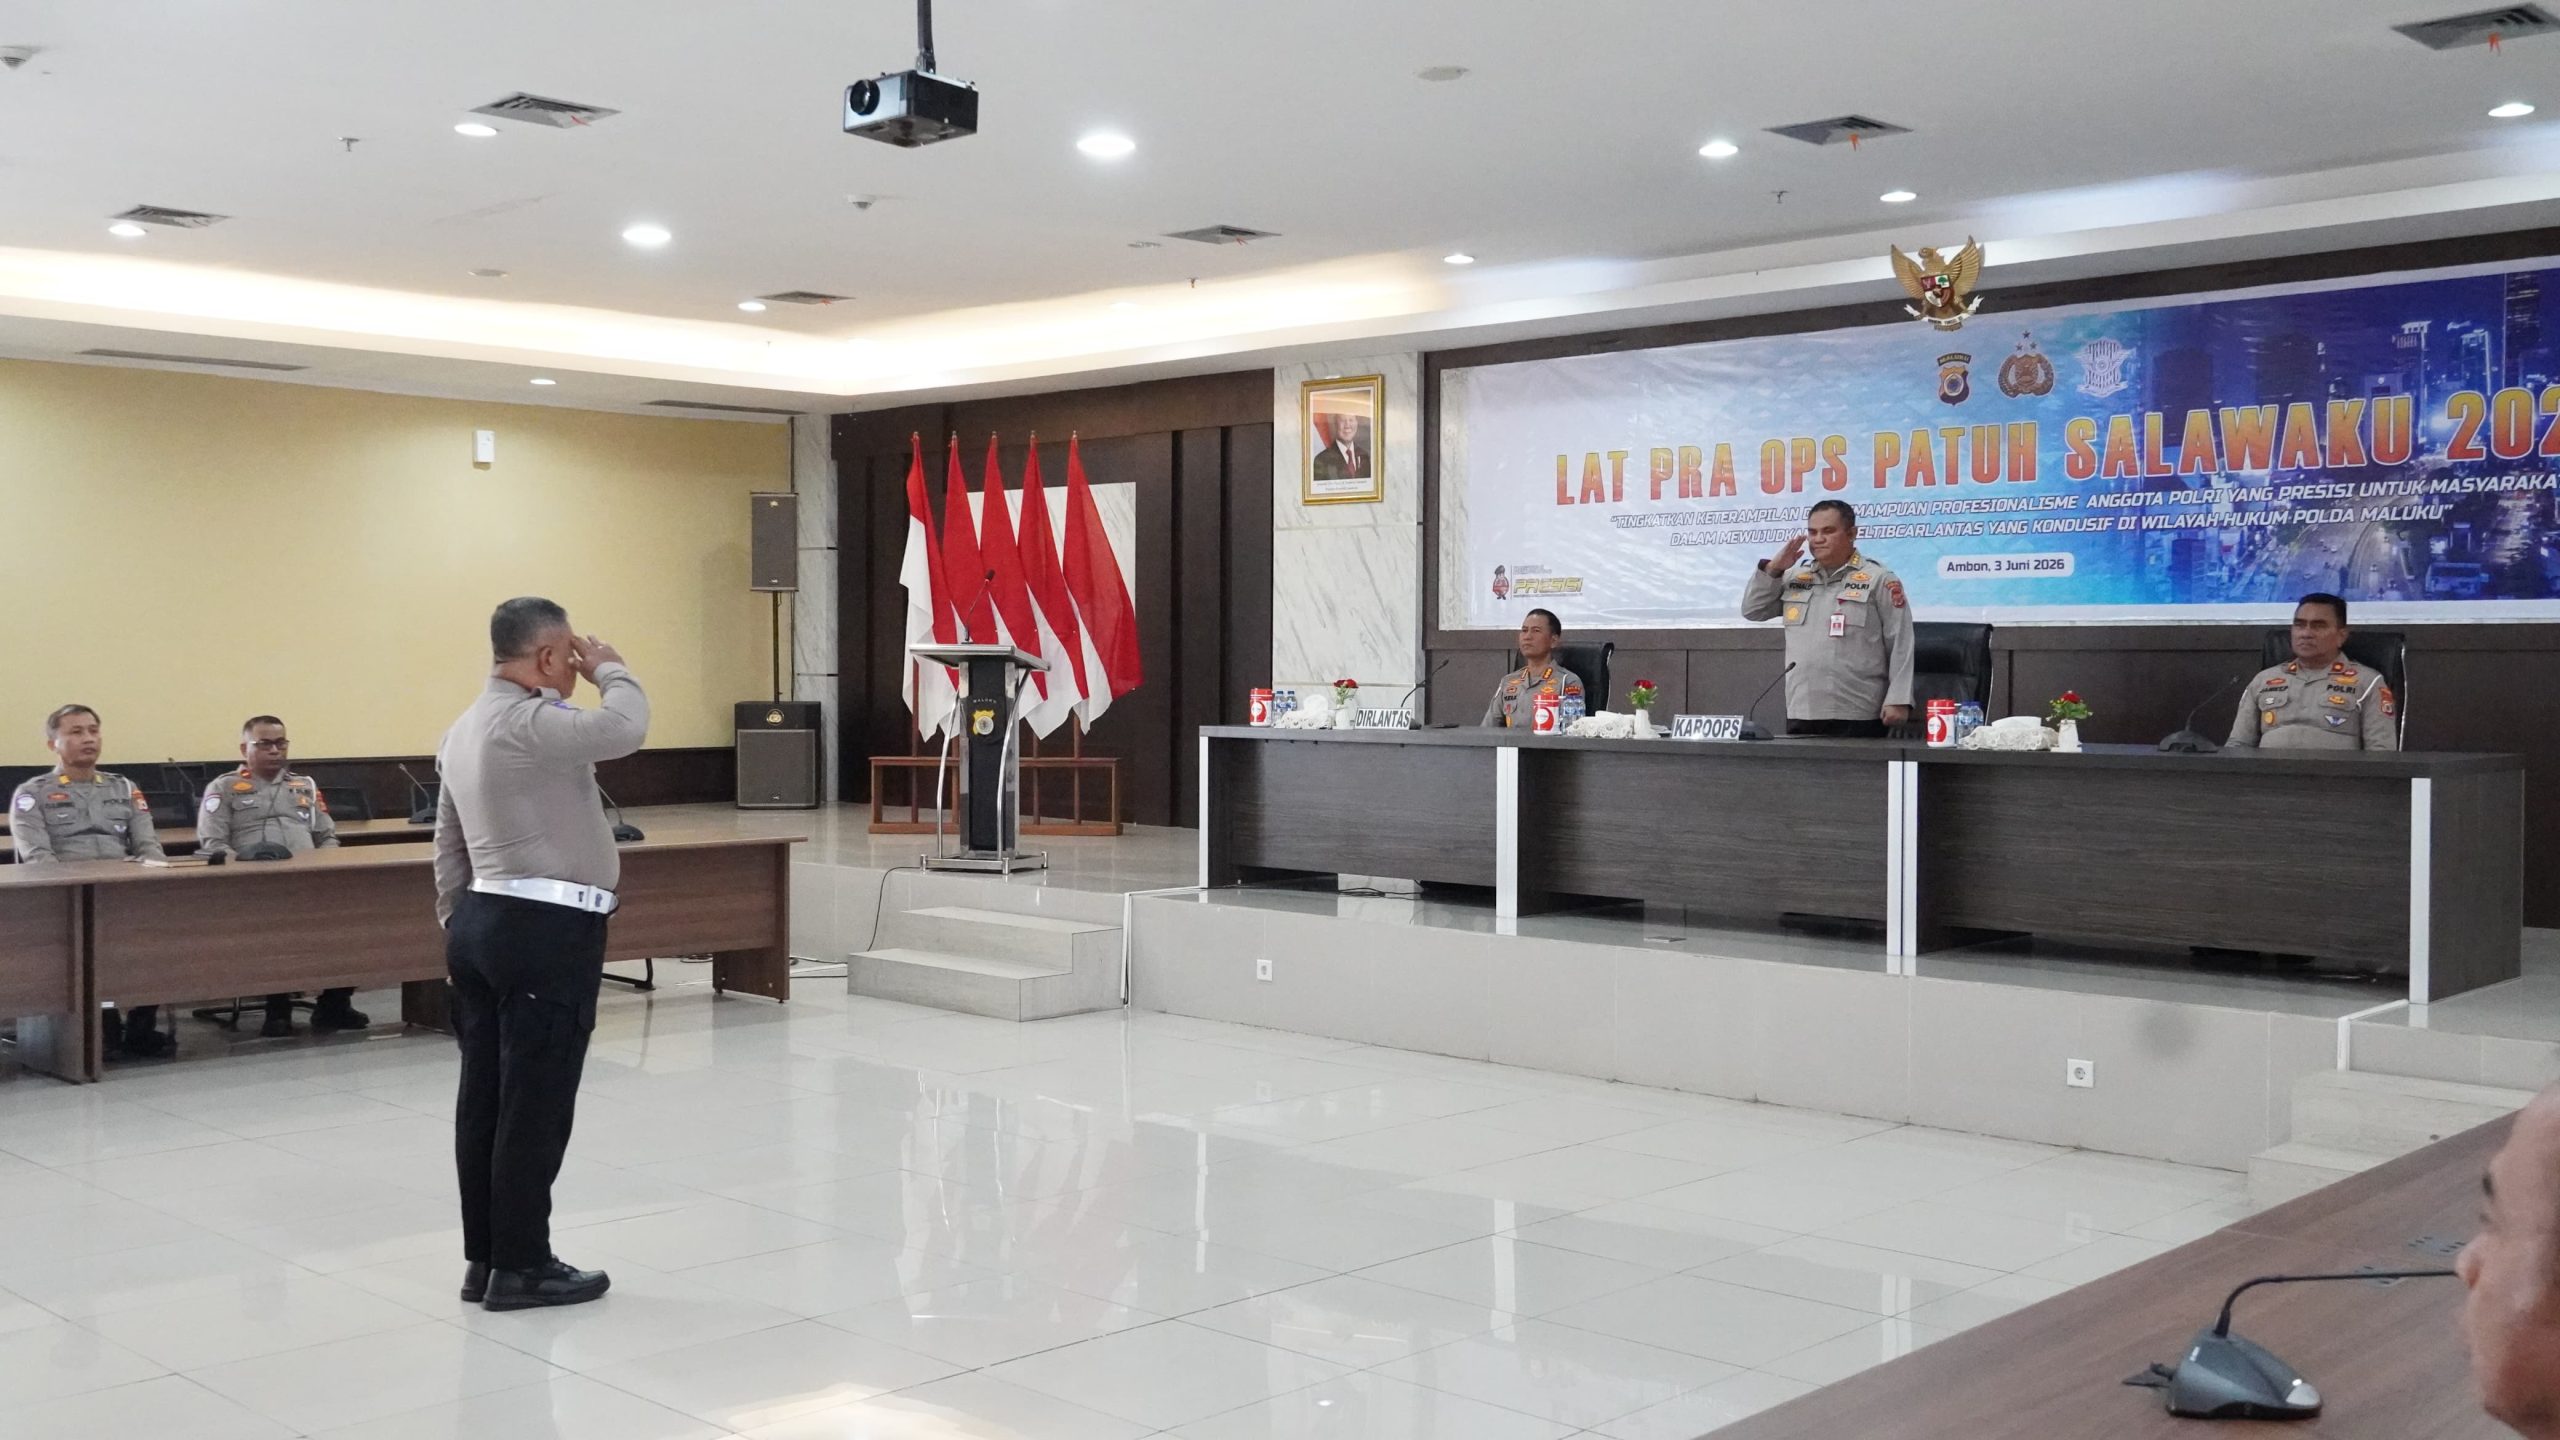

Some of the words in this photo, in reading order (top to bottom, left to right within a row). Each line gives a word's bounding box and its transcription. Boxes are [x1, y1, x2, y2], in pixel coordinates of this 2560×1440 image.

[1556, 451, 1628, 505] LAT
[1650, 443, 1736, 500] PRA
[1761, 435, 1847, 494] OPS
[1873, 420, 2038, 489] PATUH
[2065, 395, 2412, 480] SALAWAKU
[1696, 506, 1800, 525] KETERAMPILAN
[1853, 501, 1928, 518] MAMPUAN
[1932, 496, 2079, 515] PROFESIONALISME
[2086, 492, 2162, 508] ANGGOTA
[2168, 489, 2222, 505] POLRI
[2228, 487, 2274, 502] YANG
[2279, 483, 2355, 500] PRESISI
[2360, 480, 2425, 496] UNTUK
[2430, 474, 2560, 494] MASYARAKA
[1671, 531, 1718, 546] DALAM
[1855, 522, 1983, 539] ELTIBCARLANTAS
[1988, 519, 2029, 536] YANG
[2032, 517, 2114, 534] KONDUSIF
[2117, 516, 2138, 531] DI
[2140, 512, 2219, 530] WILAYAH
[2223, 510, 2289, 528] HUKUM
[2292, 508, 2355, 525] POLDA
[1946, 561, 1991, 573] Ambon,
[1994, 560, 2002, 571] 3
[2005, 559, 2030, 571] Juni
[2033, 558, 2065, 570] 2026
[1845, 582, 1870, 590] POLRI
[2326, 684, 2356, 695] POLRI
[1357, 710, 1411, 728] DIRLANTAS
[1674, 718, 1740, 738] KAROOPS
